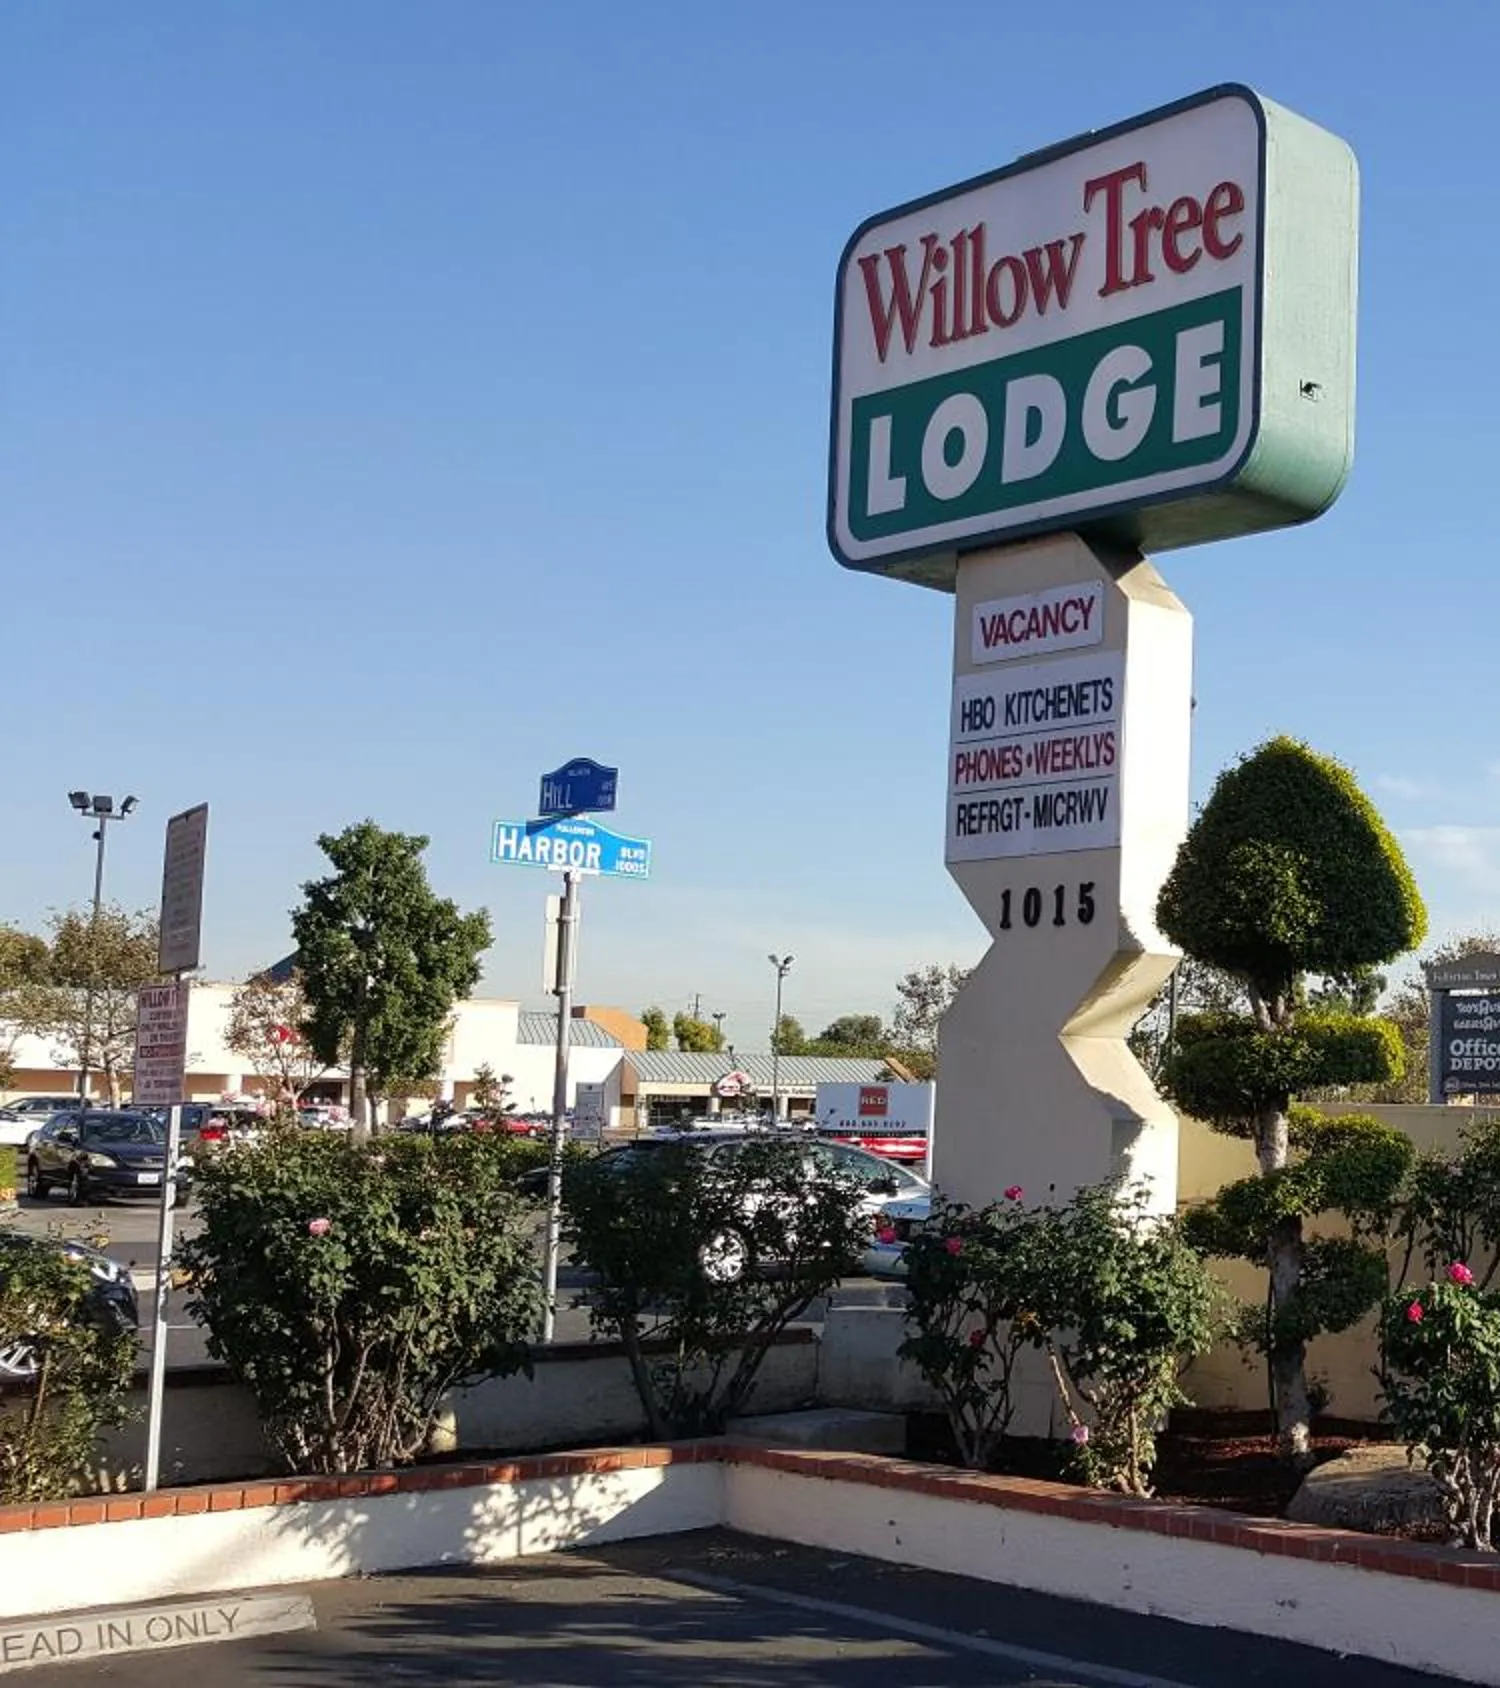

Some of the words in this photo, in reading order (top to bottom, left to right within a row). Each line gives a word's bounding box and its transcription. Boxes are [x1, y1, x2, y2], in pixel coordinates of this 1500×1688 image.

[857, 222, 1085, 364] Willow
[1083, 161, 1245, 299] Tree
[866, 319, 1225, 516] LODGE
[980, 596, 1095, 648] VACANCY
[961, 696, 995, 733] HBO
[1004, 677, 1113, 727] KITCHENETS
[498, 826, 601, 869] HARBOR
[1000, 882, 1095, 930] 1015
[1, 1626, 82, 1663] EAD
[97, 1620, 132, 1650] IN
[146, 1607, 241, 1643] ONLY
